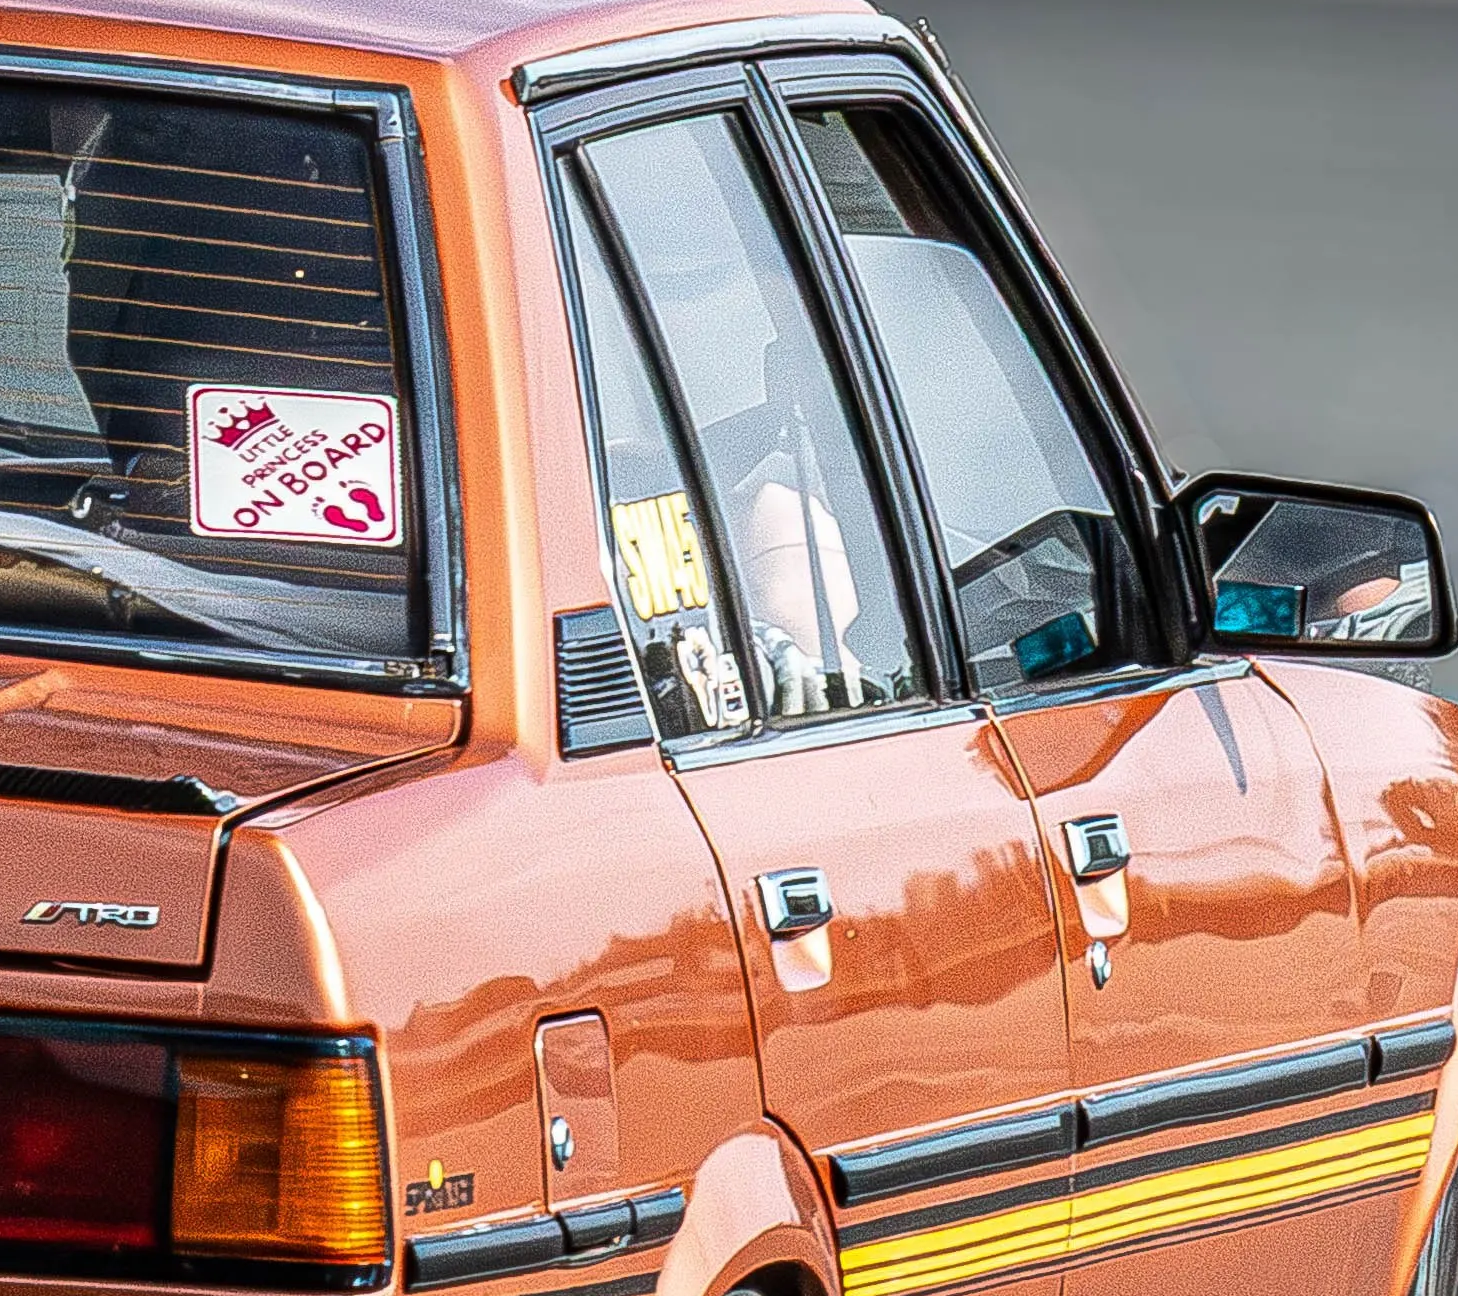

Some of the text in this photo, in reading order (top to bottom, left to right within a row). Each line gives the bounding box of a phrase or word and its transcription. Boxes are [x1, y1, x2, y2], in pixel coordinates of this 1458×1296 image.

[238, 424, 294, 463] LITTLE
[241, 429, 329, 489] PRINCESS
[233, 422, 386, 528] ON BOARD
